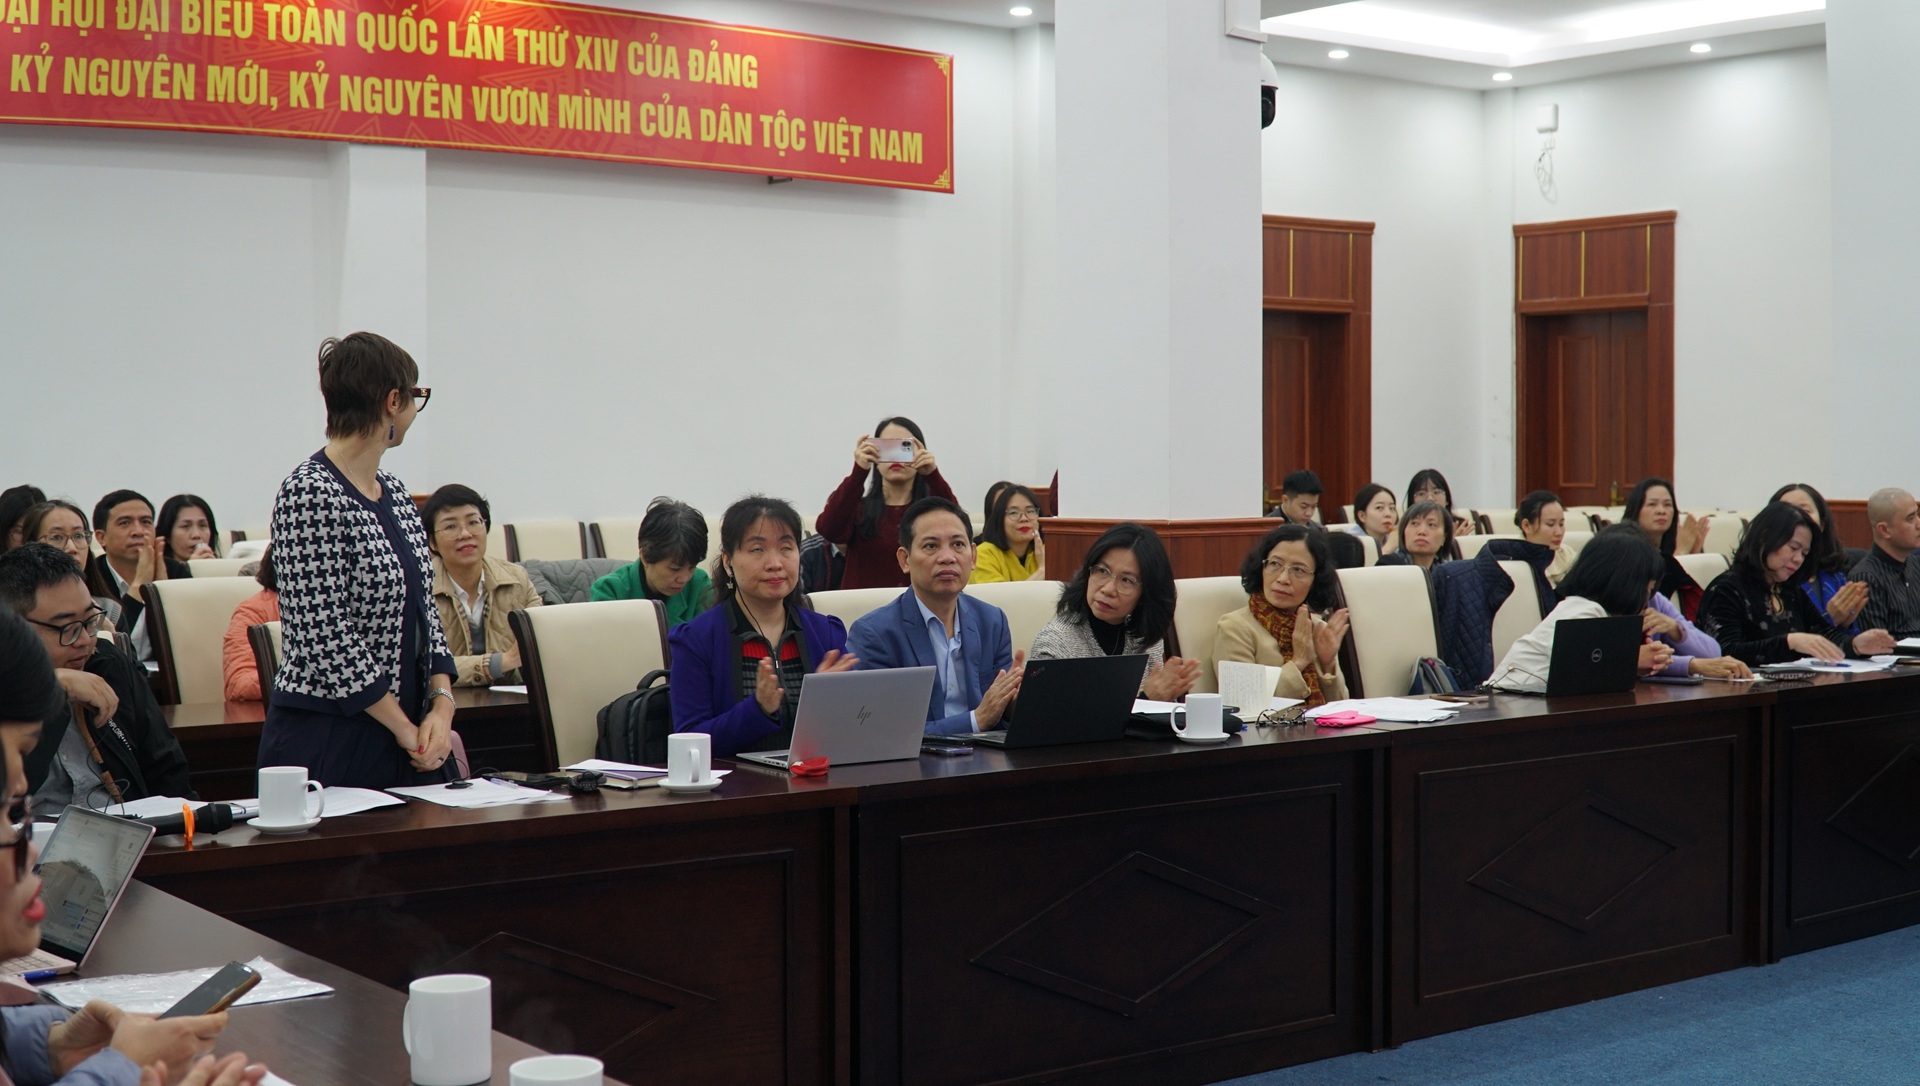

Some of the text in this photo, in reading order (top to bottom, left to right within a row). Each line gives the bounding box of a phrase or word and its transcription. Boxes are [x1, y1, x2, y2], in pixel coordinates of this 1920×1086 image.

[116, 0, 170, 40] ĐẠI
[263, 0, 346, 47] TOÀN
[357, 3, 438, 55] QUỐC
[448, 10, 504, 62] LẦN
[513, 25, 569, 68] THỨ
[575, 35, 619, 73] XIV
[627, 31, 681, 80] CỦA
[688, 38, 758, 89] ĐẢNG
[10, 41, 923, 165] KỶ NGUYÊN MỚI, KỶ NGUYÊN VƯƠN MÌNH CỦA DÂN TỘC VIỆT NAM
